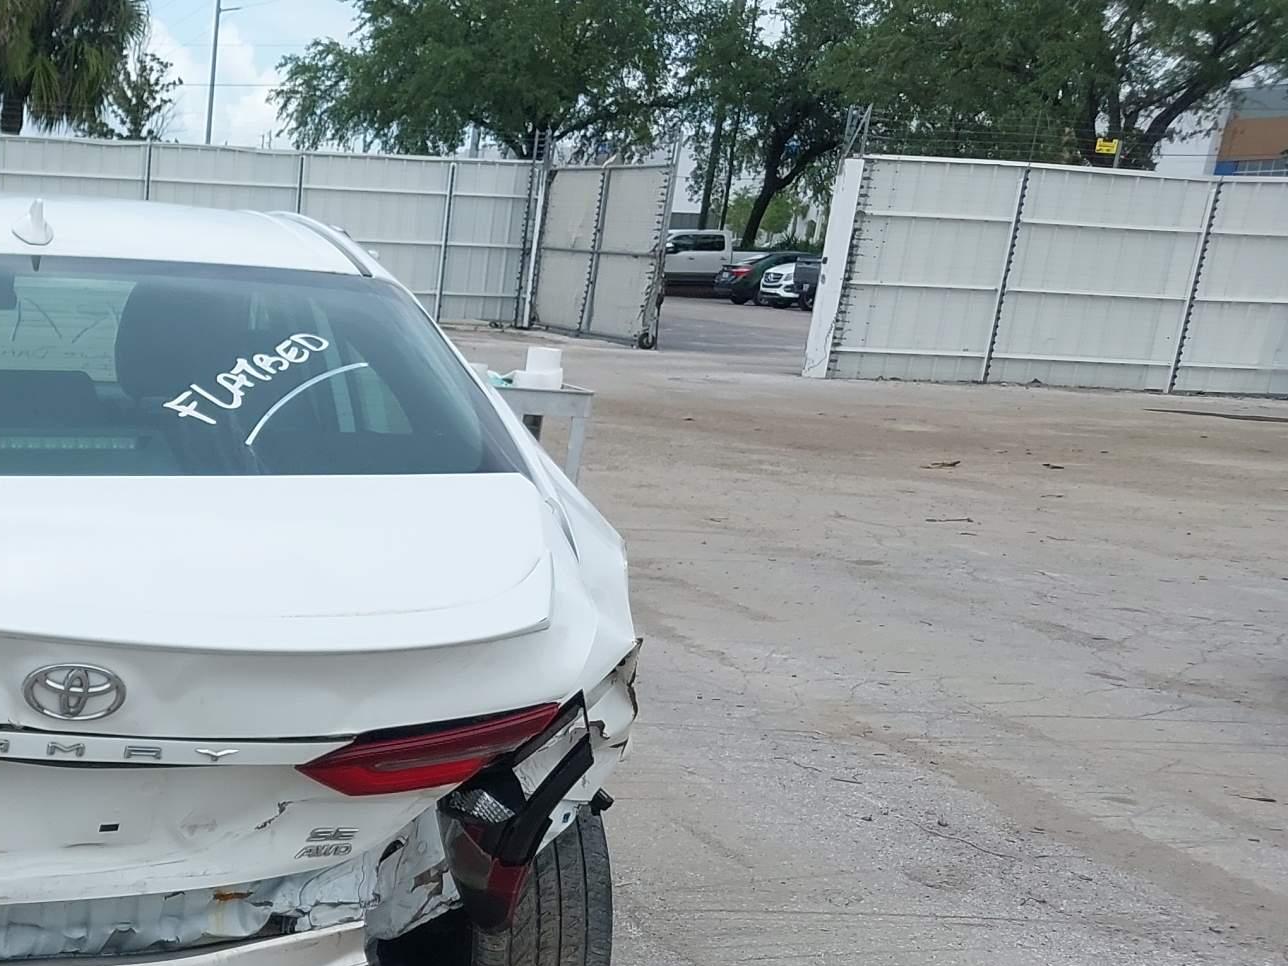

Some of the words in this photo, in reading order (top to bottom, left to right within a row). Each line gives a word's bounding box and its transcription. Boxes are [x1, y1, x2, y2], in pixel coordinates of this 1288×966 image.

[162, 332, 330, 425] FLATBED
[305, 826, 360, 842] SE
[294, 842, 353, 859] AWD
